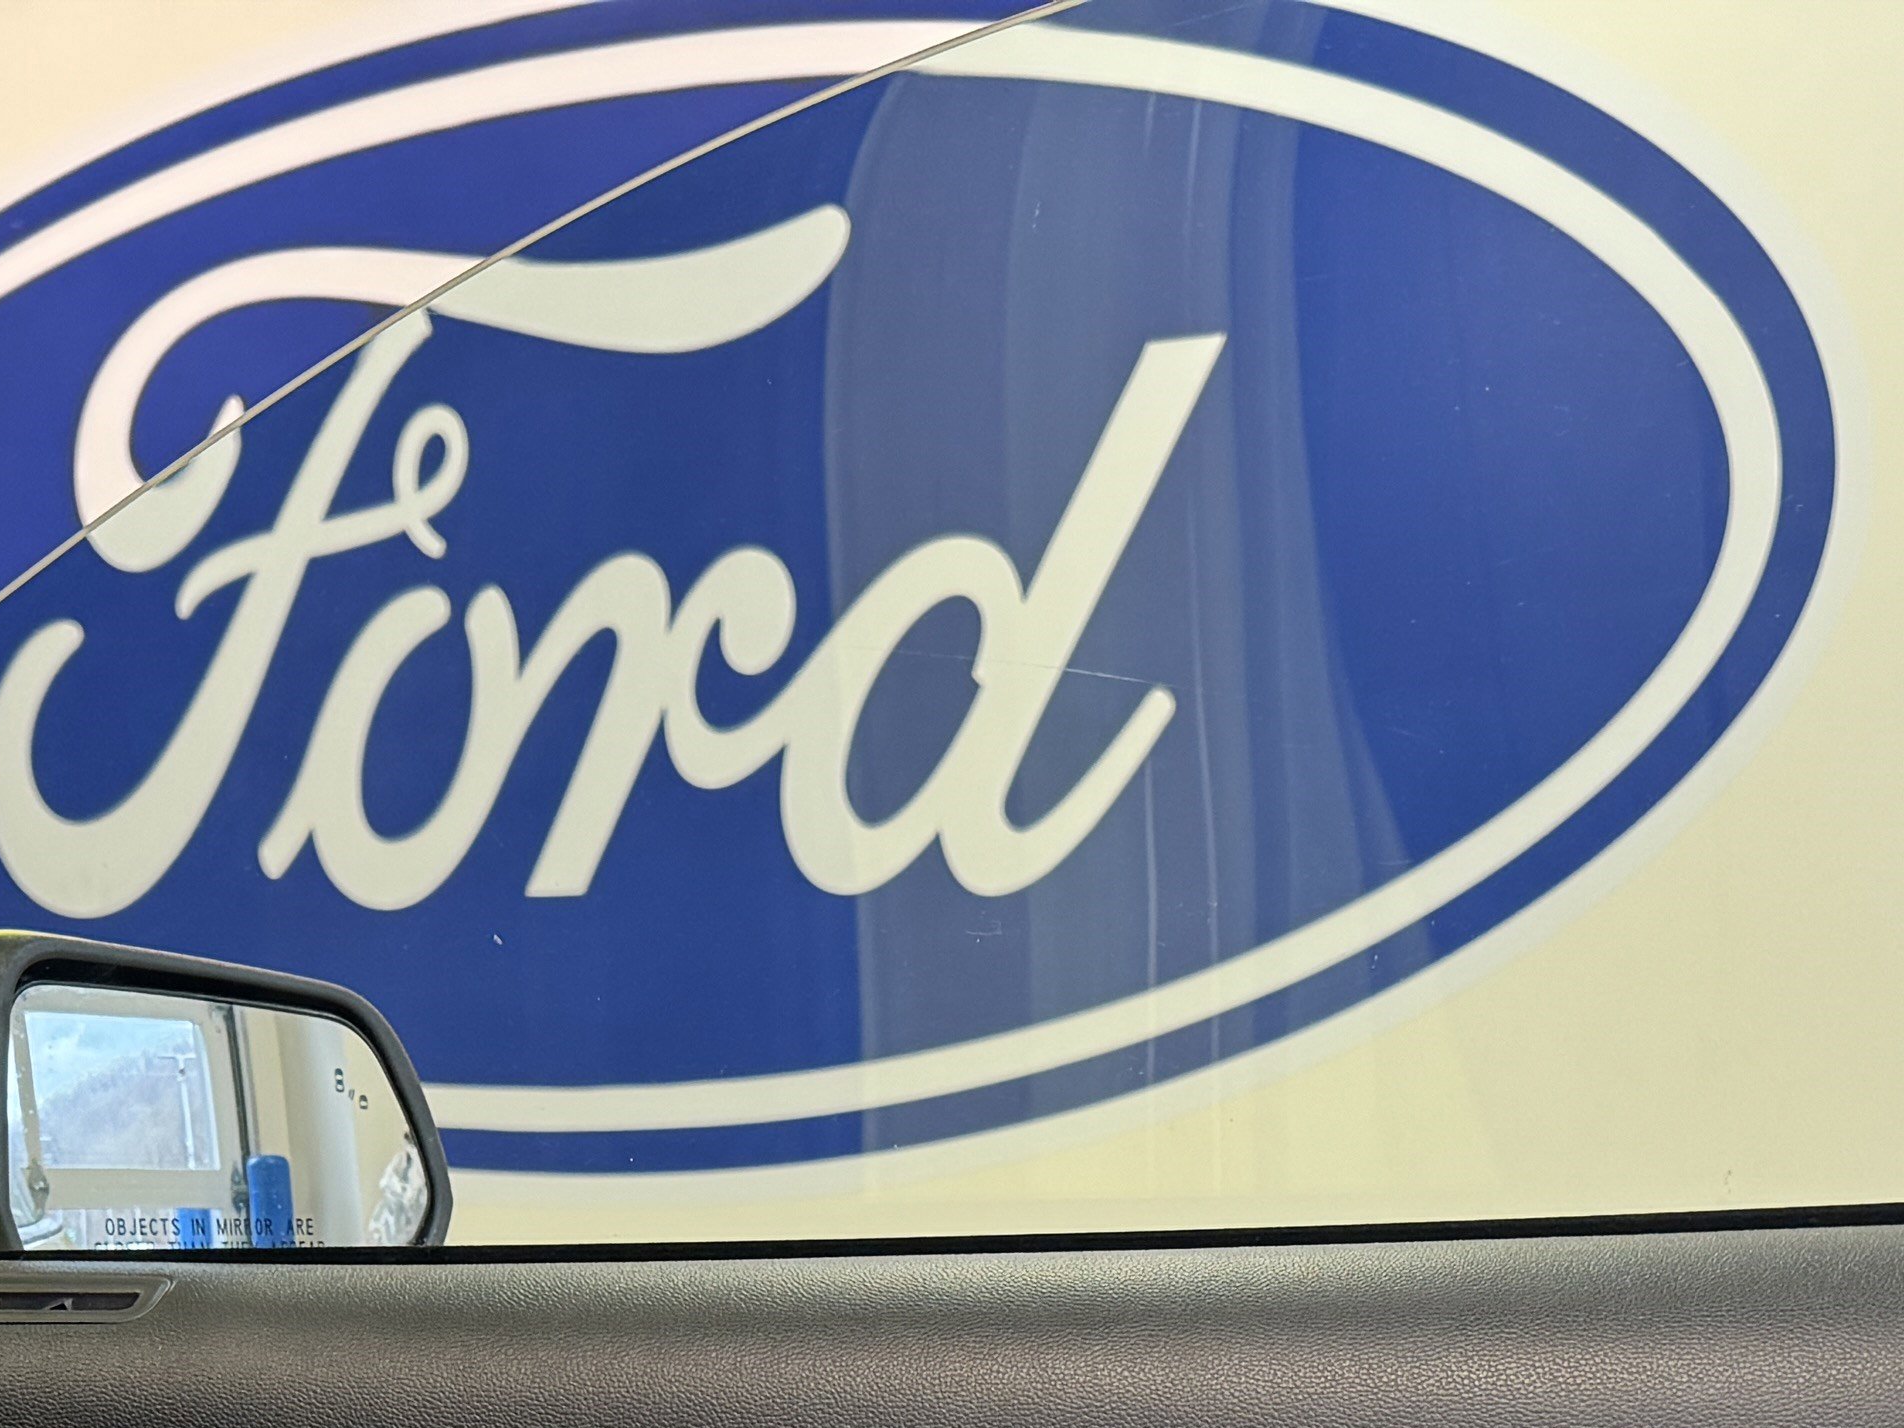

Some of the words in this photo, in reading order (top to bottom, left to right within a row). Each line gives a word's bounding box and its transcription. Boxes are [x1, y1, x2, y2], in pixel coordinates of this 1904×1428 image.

[104, 1217, 181, 1237] OBJECTS
[190, 1217, 207, 1237] IN
[216, 1217, 274, 1237] MIRROR
[285, 1217, 315, 1237] ARE
